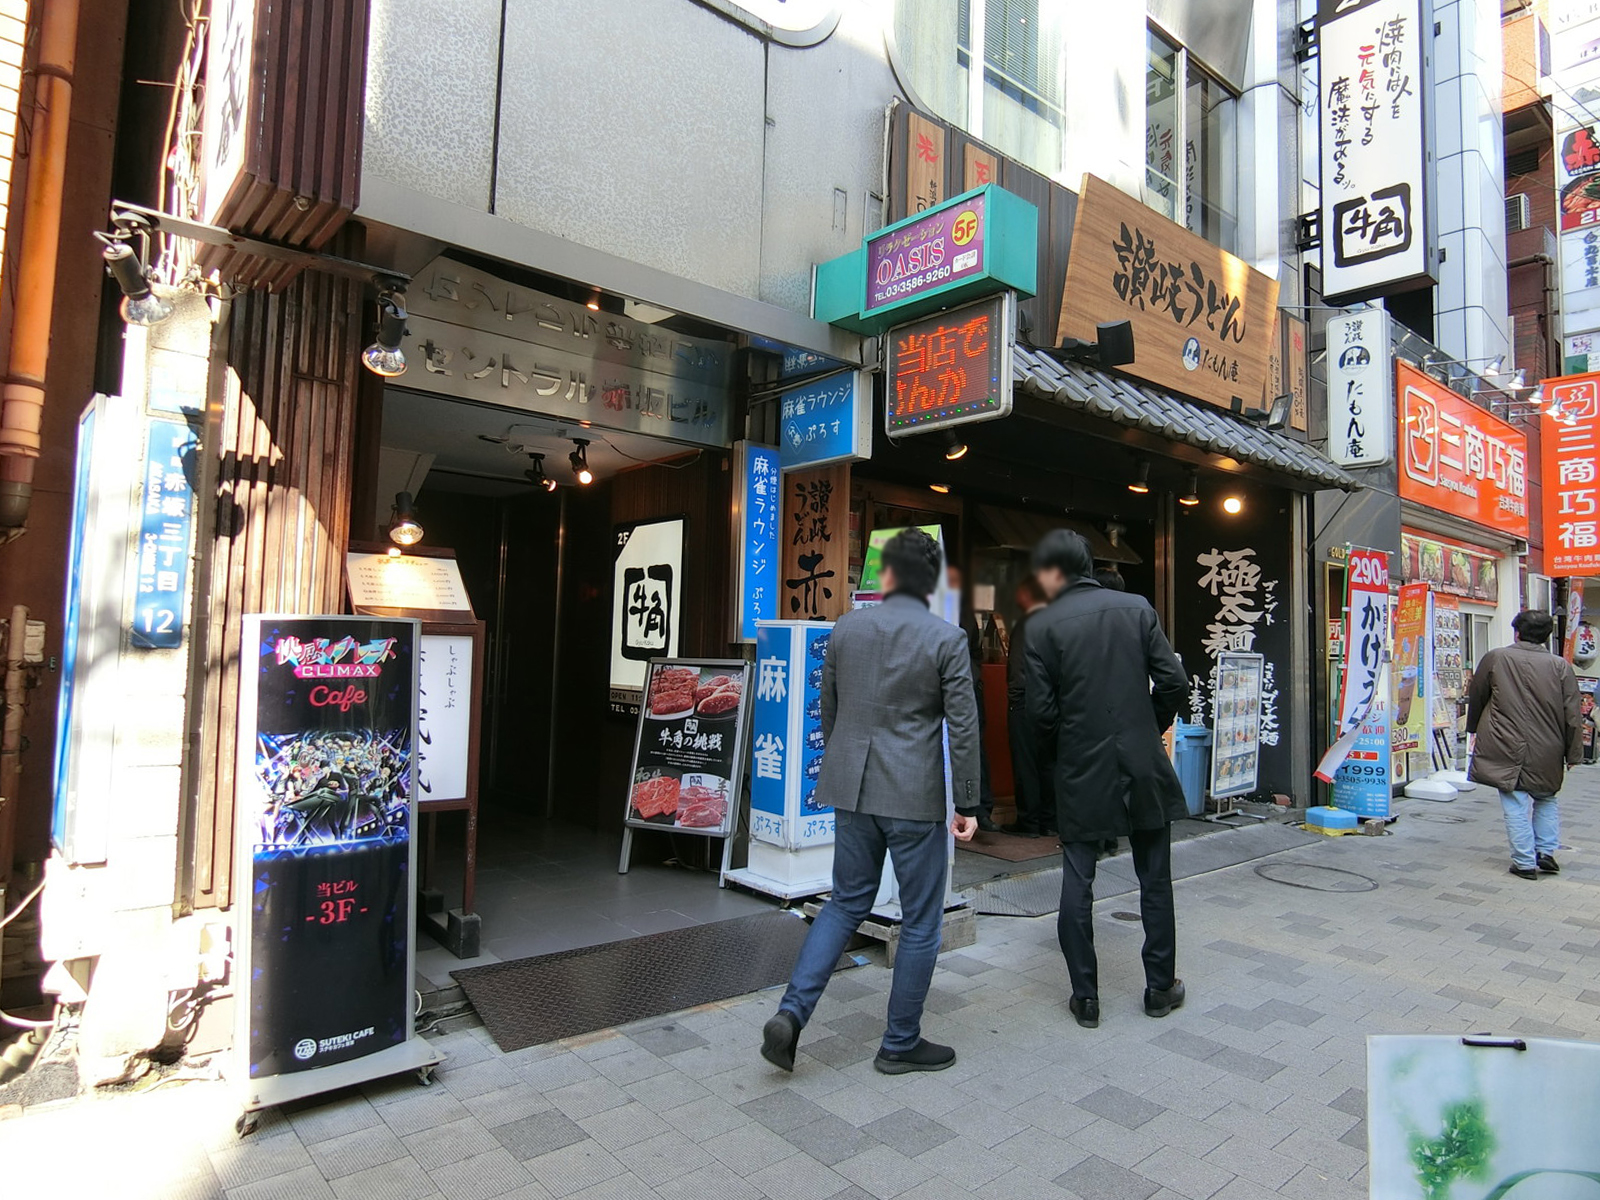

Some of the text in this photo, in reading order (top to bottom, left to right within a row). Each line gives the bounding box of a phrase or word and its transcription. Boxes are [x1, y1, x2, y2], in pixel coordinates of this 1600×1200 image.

[1358, 45, 1381, 146] 元気にする
[953, 219, 977, 242] 5F
[1344, 206, 1403, 244] 牛角
[876, 237, 946, 286] OASIS
[1112, 221, 1246, 344] 讃岐うどん
[896, 316, 989, 376] 当店で
[782, 383, 851, 419] 麻雀ラウンジ
[1345, 379, 1365, 458] たもん庵
[805, 418, 841, 442] ぷろす
[1439, 409, 1525, 498] 三商巧福
[769, 467, 778, 541] 分煙はじめました
[1557, 424, 1598, 549] 三商巧福
[752, 456, 770, 575] 麻雀ラウンジ
[617, 532, 629, 546] 2F
[141, 608, 174, 634] 12
[629, 583, 665, 639] 牛角
[302, 665, 377, 677] CLIMAX
[309, 684, 368, 713] Cafe
[610, 704, 626, 713] TEL
[658, 727, 723, 751] 牛角の挑戦
[753, 815, 782, 838] ぷろす
[316, 880, 358, 897] 当ビル
[319, 1026, 375, 1047] SUTEKI CAFE
